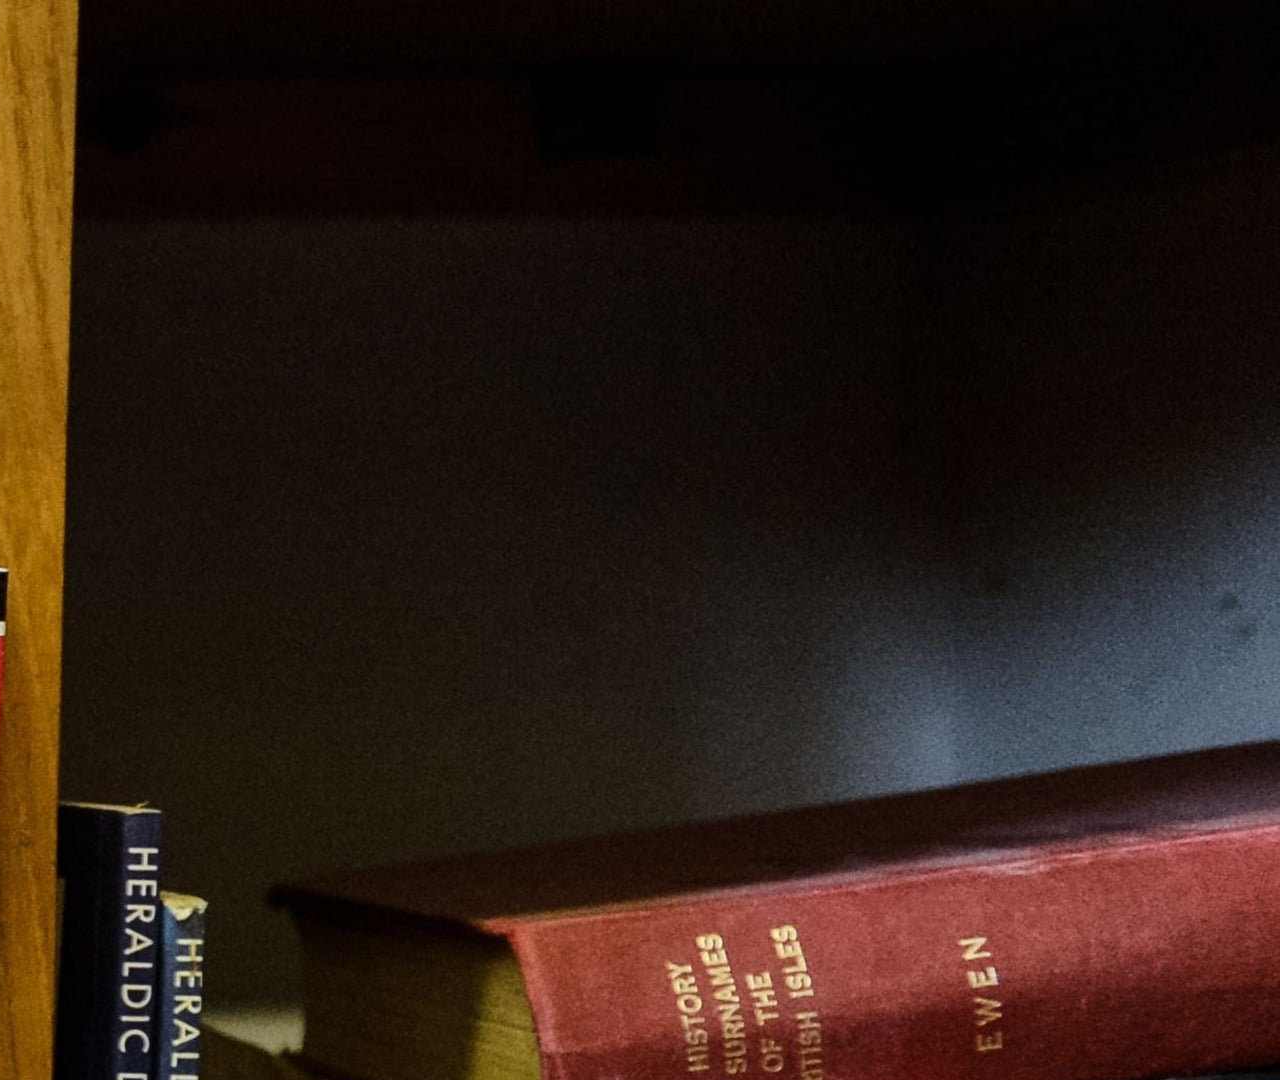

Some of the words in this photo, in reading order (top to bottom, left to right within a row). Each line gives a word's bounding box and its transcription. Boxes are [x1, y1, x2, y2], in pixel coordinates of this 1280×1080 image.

[116, 848, 159, 1054] HERALDIC
[696, 932, 748, 1075] SURNAMES
[746, 969, 780, 1026] THE
[771, 923, 815, 998] ISLES
[958, 935, 1004, 1053] EWEN
[666, 960, 710, 1073] HISTORY
[762, 1037, 785, 1073] OF
